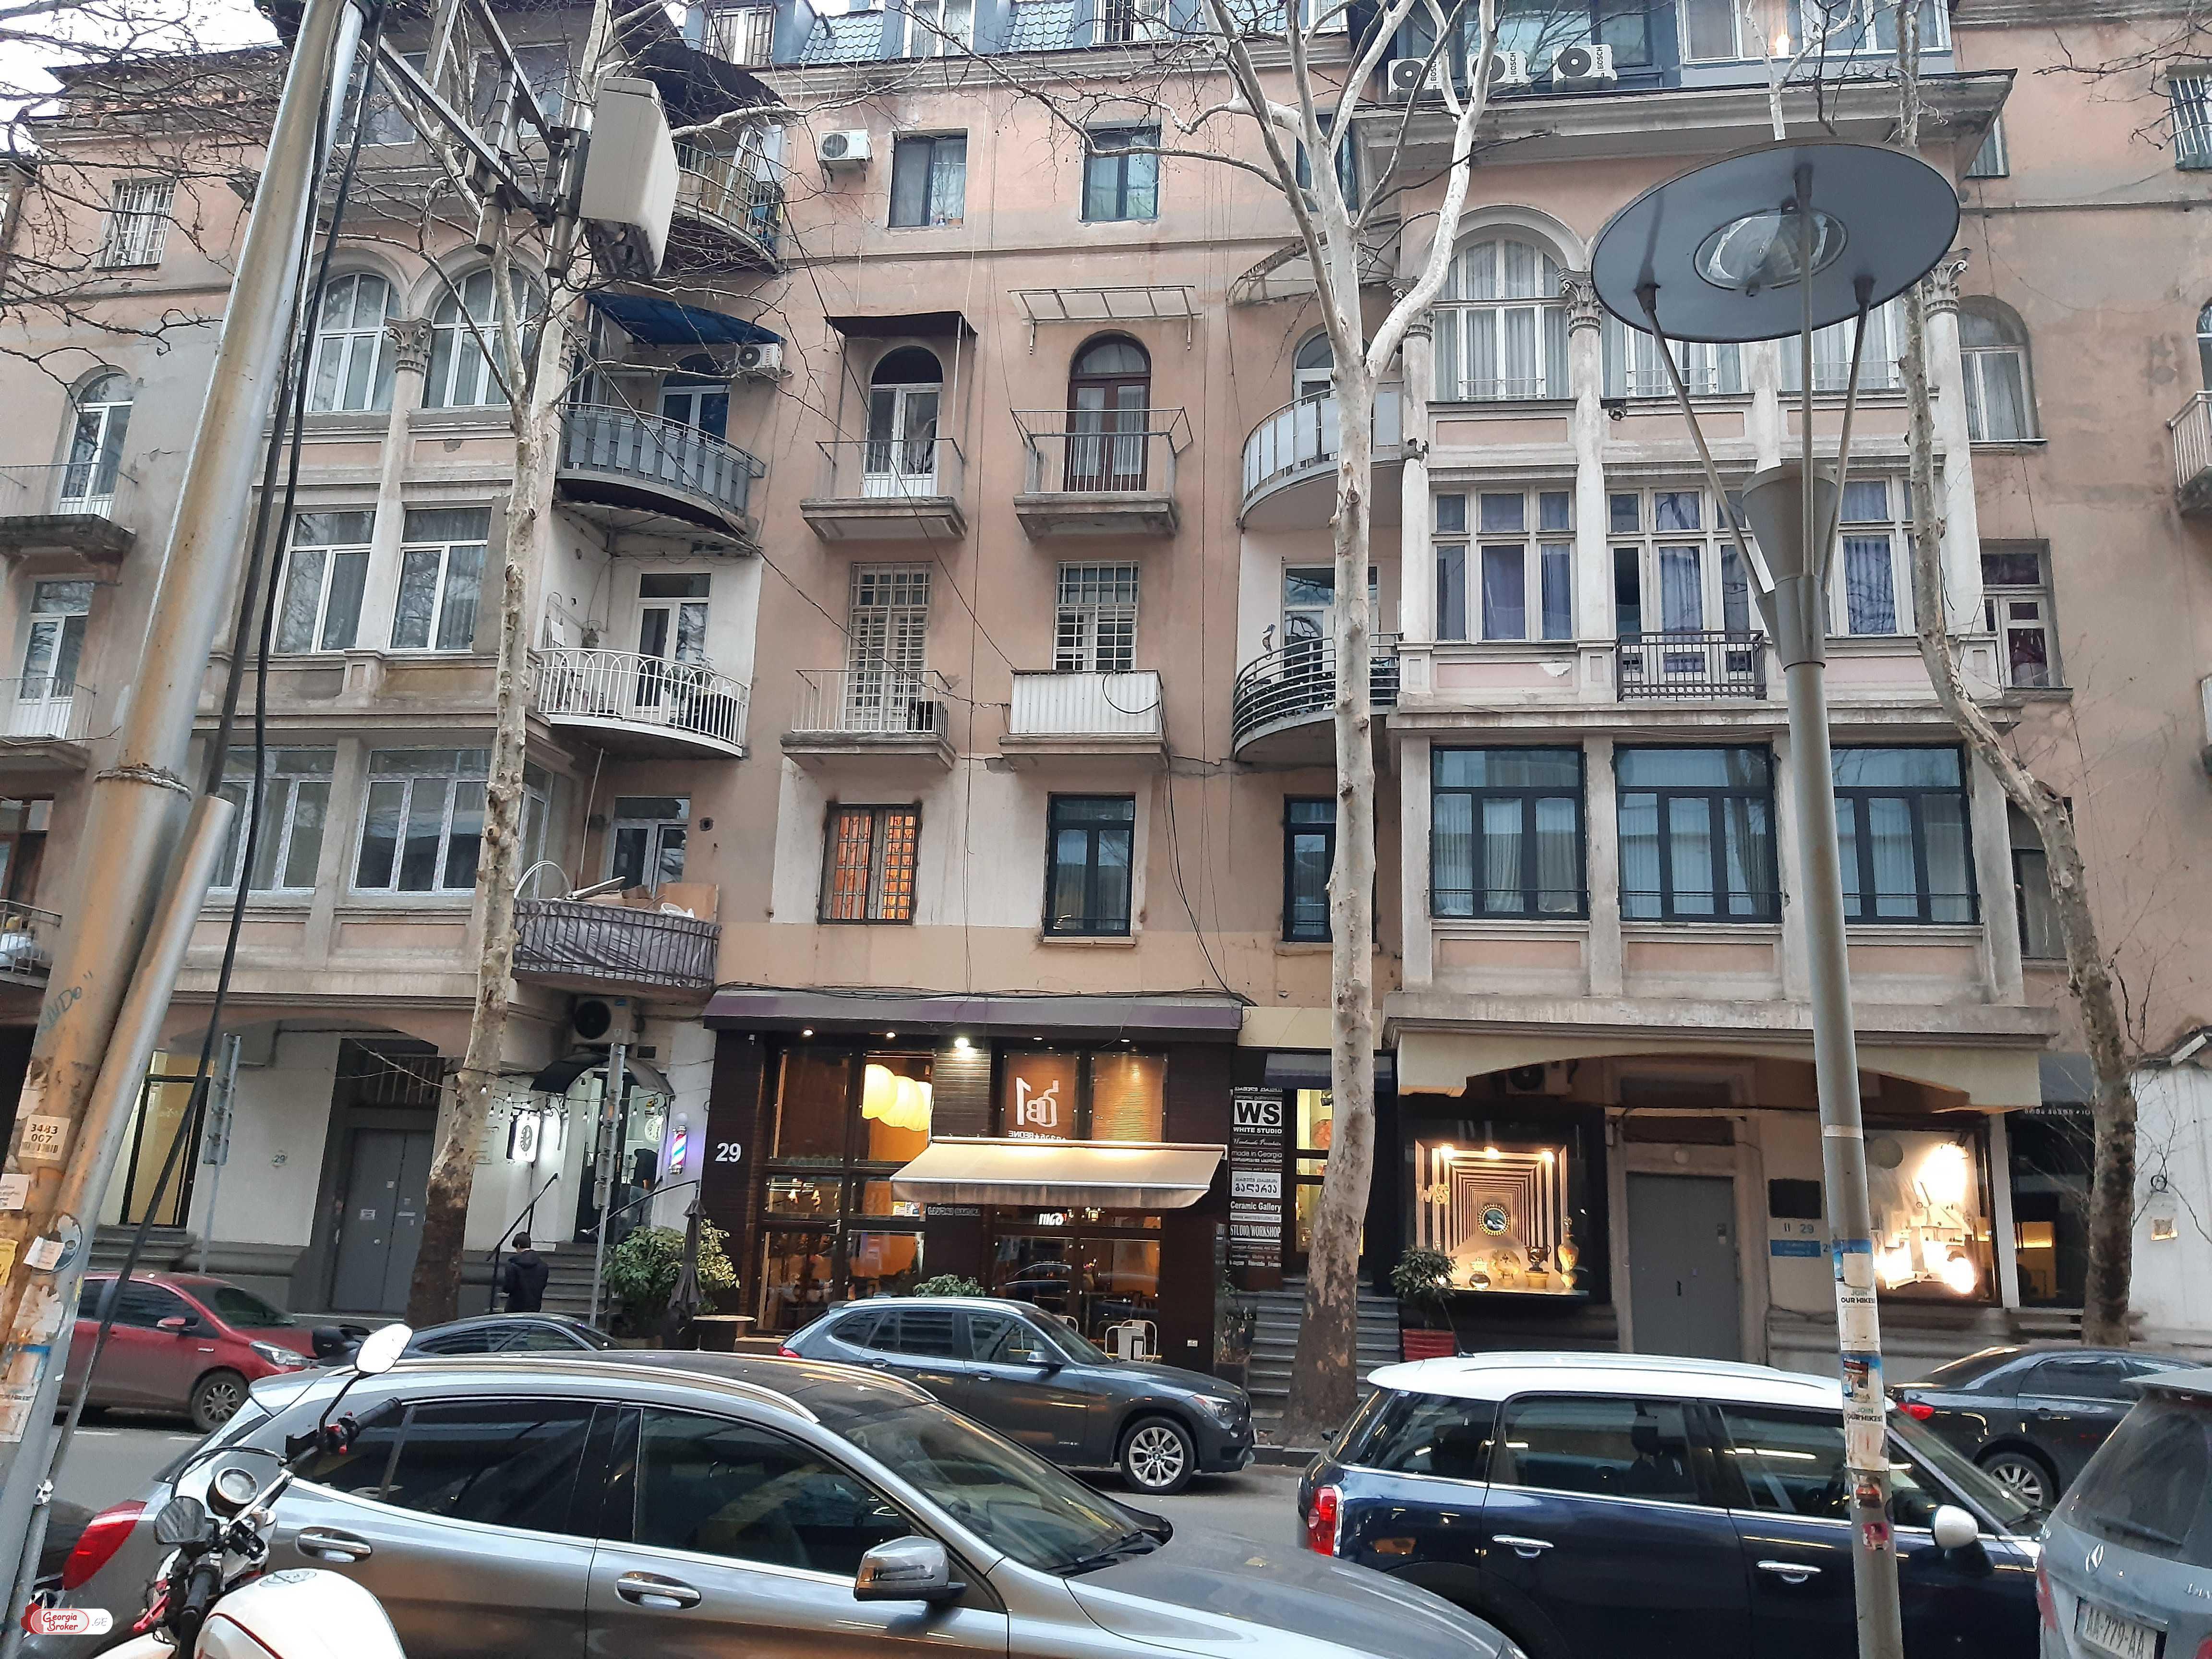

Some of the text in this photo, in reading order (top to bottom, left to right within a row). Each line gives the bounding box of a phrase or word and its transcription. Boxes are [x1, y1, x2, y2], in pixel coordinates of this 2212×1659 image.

[1236, 1102, 1280, 1125] WS
[31, 1124, 58, 1134] 3483
[31, 1134, 52, 1143] 007
[715, 1142, 741, 1162] 29
[1257, 1151, 1282, 1159] Georgia
[1235, 1183, 1277, 1193] გალერეა
[1416, 1183, 1450, 1205] WS
[1230, 1201, 1282, 1214] Ceramic Gallery
[1230, 1224, 1281, 1238] STUDIO/WORKSHOP
